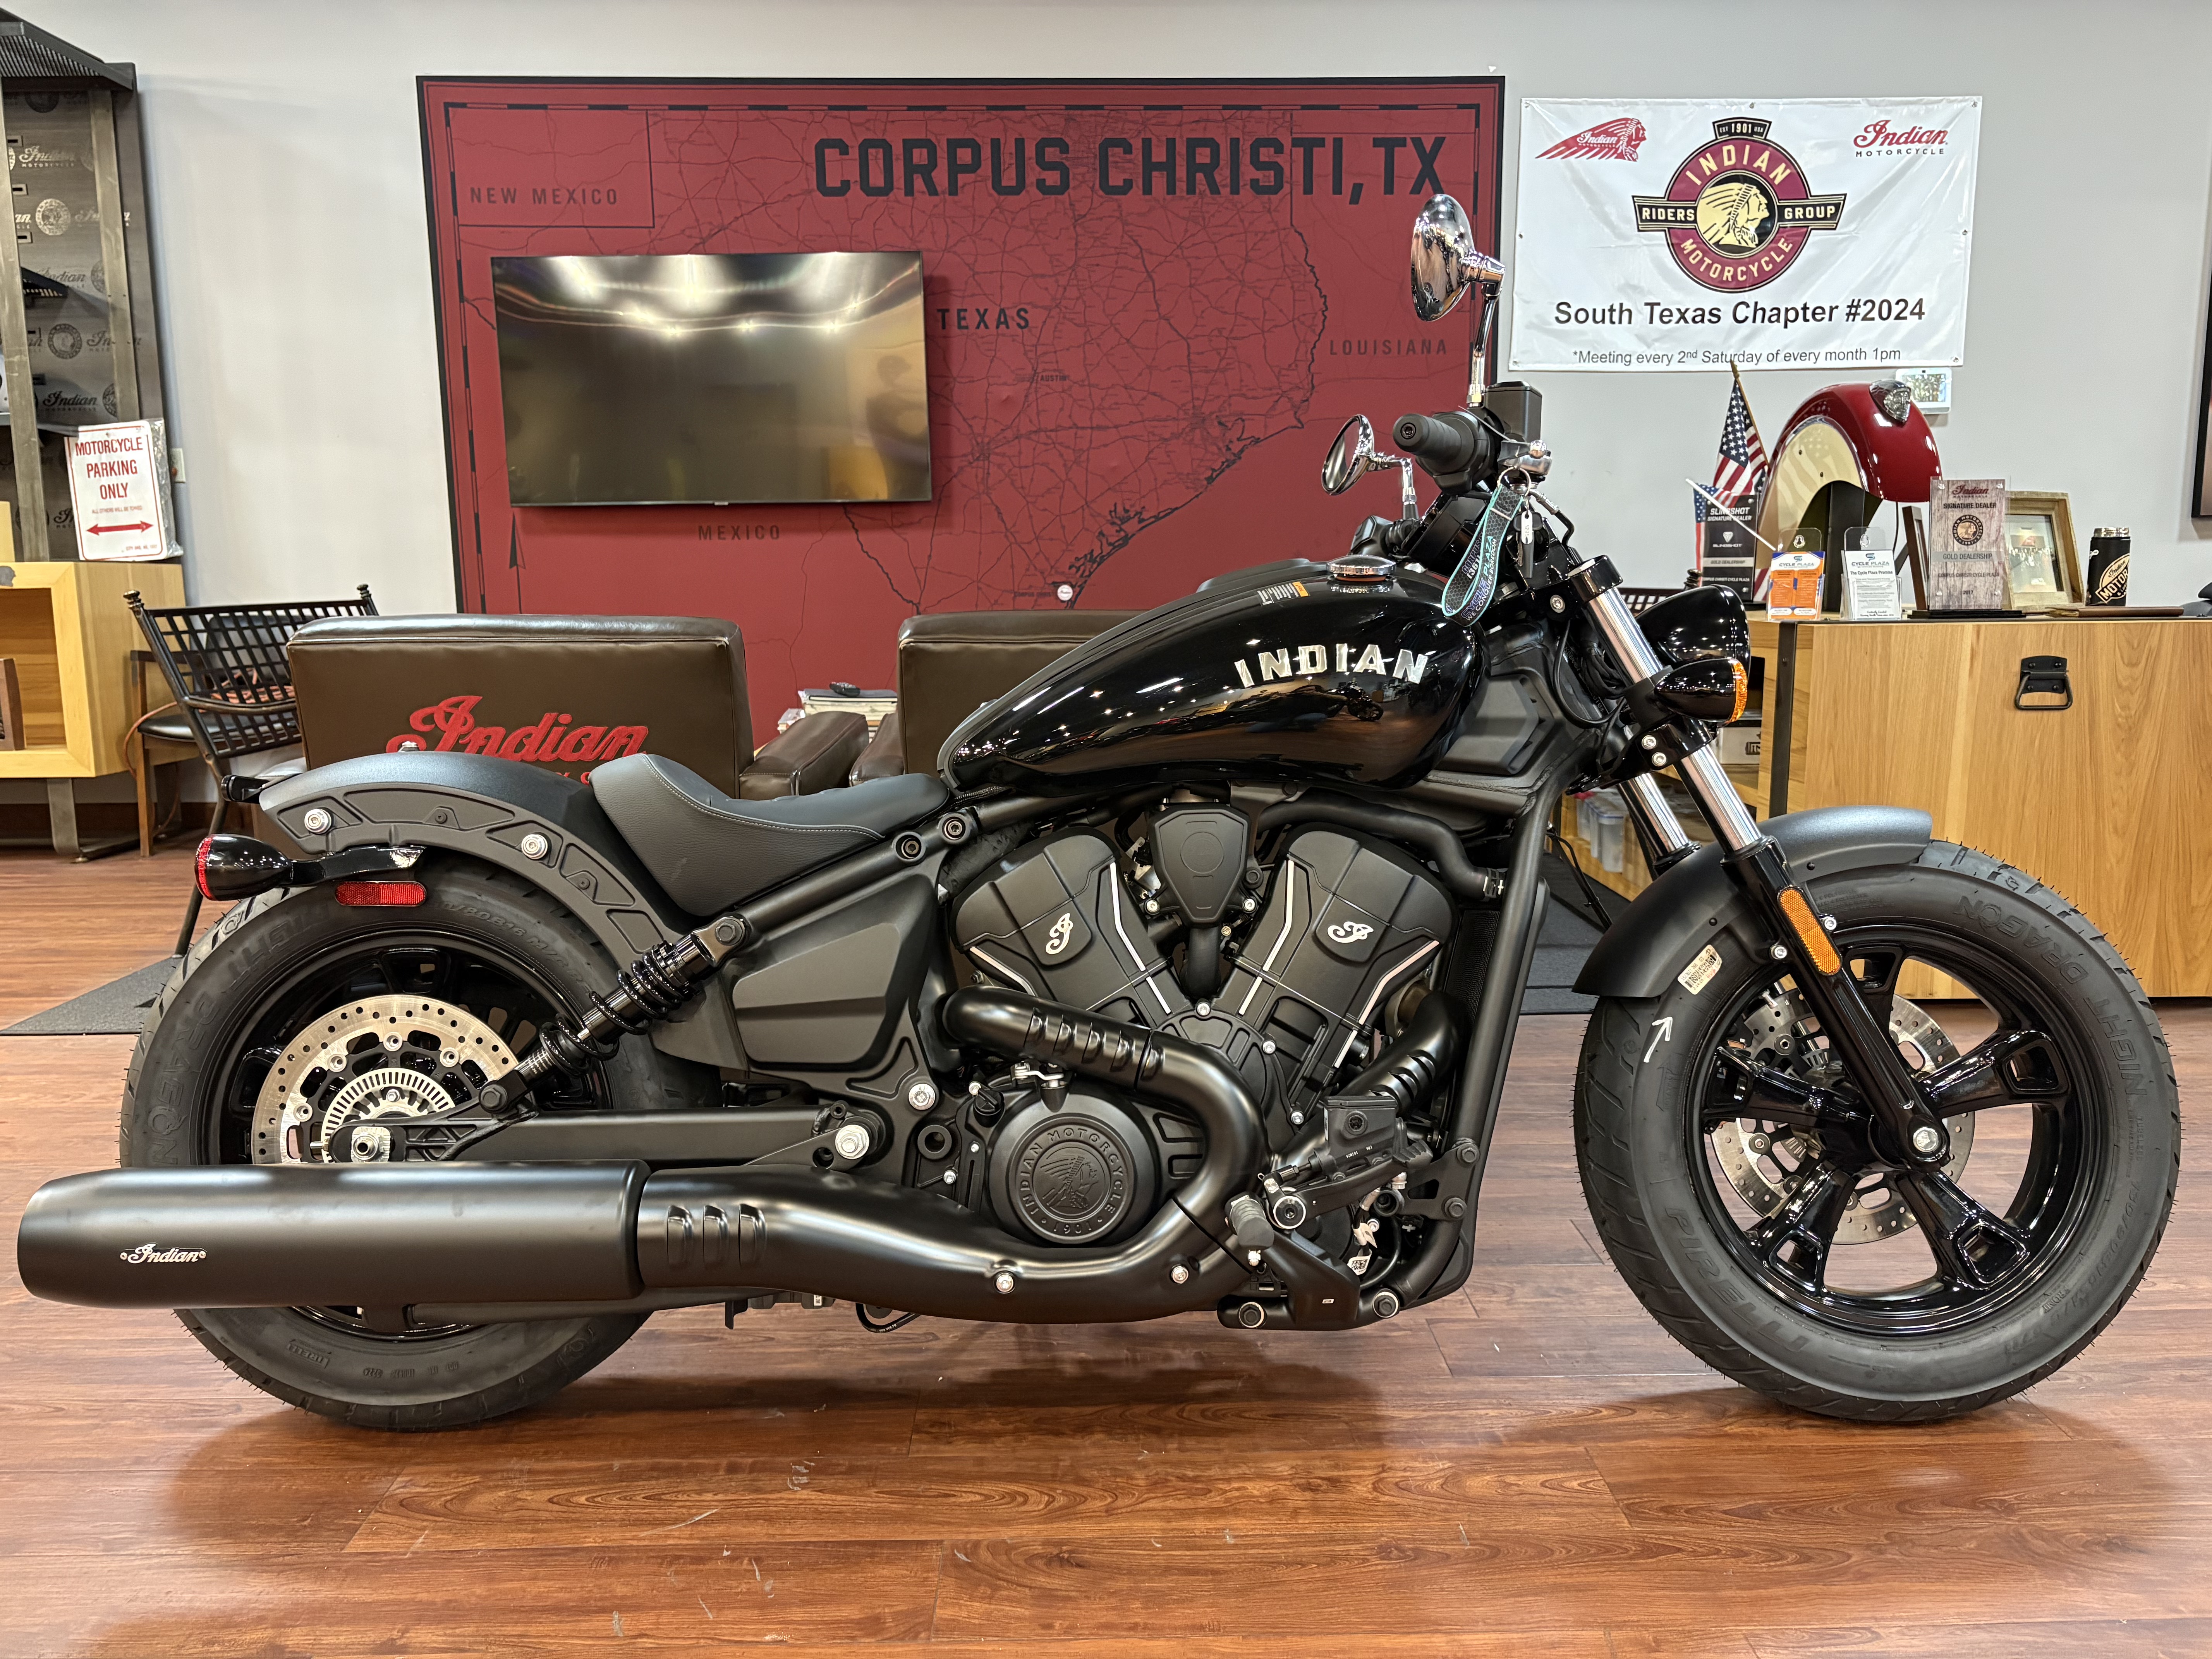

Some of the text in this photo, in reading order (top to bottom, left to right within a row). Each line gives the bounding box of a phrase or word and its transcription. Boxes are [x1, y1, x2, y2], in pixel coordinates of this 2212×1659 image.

[1577, 131, 1618, 143] Indian
[1731, 124, 1752, 133] 1901
[1853, 120, 1948, 148] Indian
[1856, 148, 1944, 157] MOTORCYCLE
[815, 137, 1069, 197] CORPUS
[1685, 145, 1791, 185] INDIAN
[470, 187, 617, 205] NEW MEXICO
[1642, 205, 1836, 221] RIDERS GROUP
[1681, 237, 1793, 281] MOTORCYCLE
[936, 308, 1029, 330] TEXAS
[1554, 298, 1925, 329] South Texas Chapter #2024
[1330, 339, 1446, 356] LOUISIANA
[1637, 353, 1673, 366] every
[1678, 349, 1698, 363] 2nd
[1702, 349, 1762, 365] Saturday
[1767, 349, 1781, 362] of
[1783, 351, 1820, 364] every
[1825, 347, 1867, 361] month
[1872, 347, 1900, 363] 1pm
[43, 391, 97, 407] Indian
[75, 436, 143, 456] MOTORCYCLE
[86, 459, 138, 478] PARKING
[100, 483, 128, 500] ONLY
[1952, 484, 1989, 495] Indian
[698, 524, 780, 541] MEXICO
[1483, 536, 1494, 577] PLAZA
[1489, 538, 1498, 574] BOREDOM
[1461, 577, 1487, 618] CYCLE
[1466, 574, 1493, 621] WE CONQUER
[1234, 643, 1428, 688] INDIAN
[386, 695, 649, 762] Indian
[2083, 996, 2147, 1096] NIGHT
[1020, 1127, 1123, 1215] INDIAN MOTORCYCLE
[1053, 1221, 1092, 1234] 1901
[128, 1243, 199, 1264] Indian
[1665, 1207, 1810, 1353] PIRELLI
